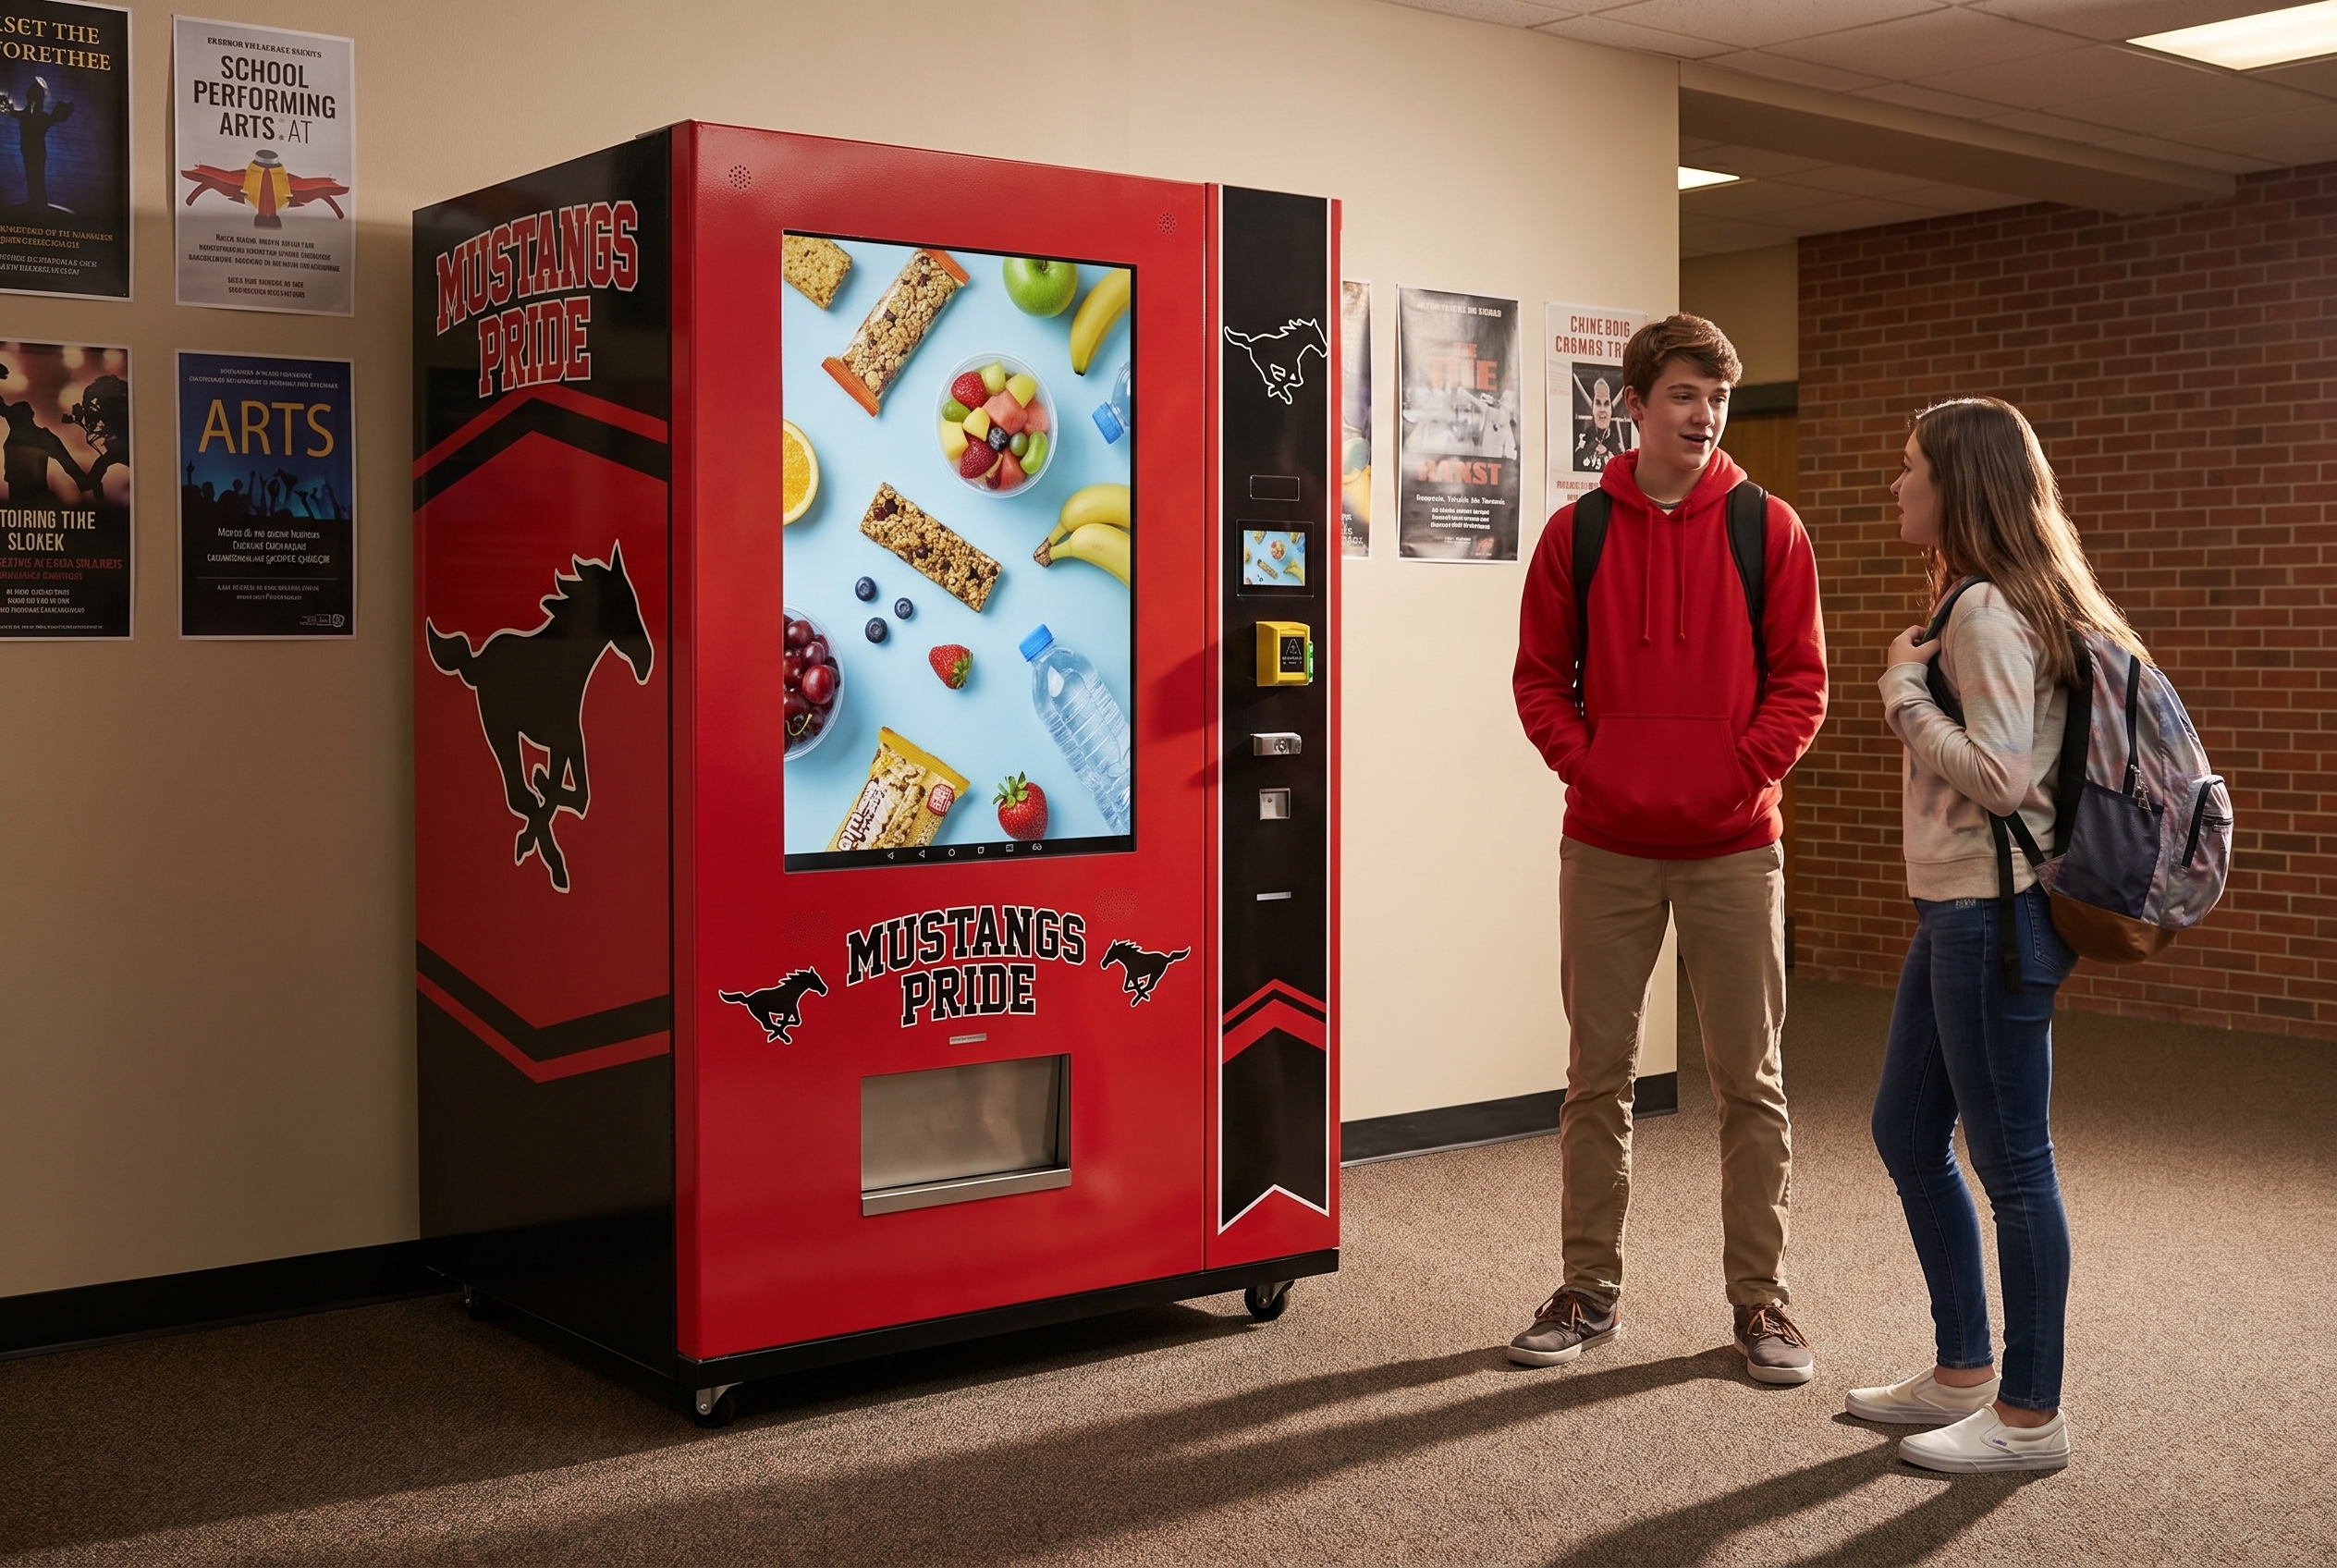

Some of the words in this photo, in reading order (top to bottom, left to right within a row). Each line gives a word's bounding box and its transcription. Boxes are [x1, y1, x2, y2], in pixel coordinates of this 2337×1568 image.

[52, 21, 100, 45] THE
[193, 80, 336, 119] PERFORMING
[220, 55, 309, 89] SCHOOL
[436, 200, 638, 337] MUSTANGS
[478, 295, 591, 398] PRIDE
[1605, 319, 1630, 337] BOIG
[198, 398, 335, 458] ARTS
[847, 905, 1086, 987] MUSTANGS
[901, 962, 1036, 1029] PRIDE
